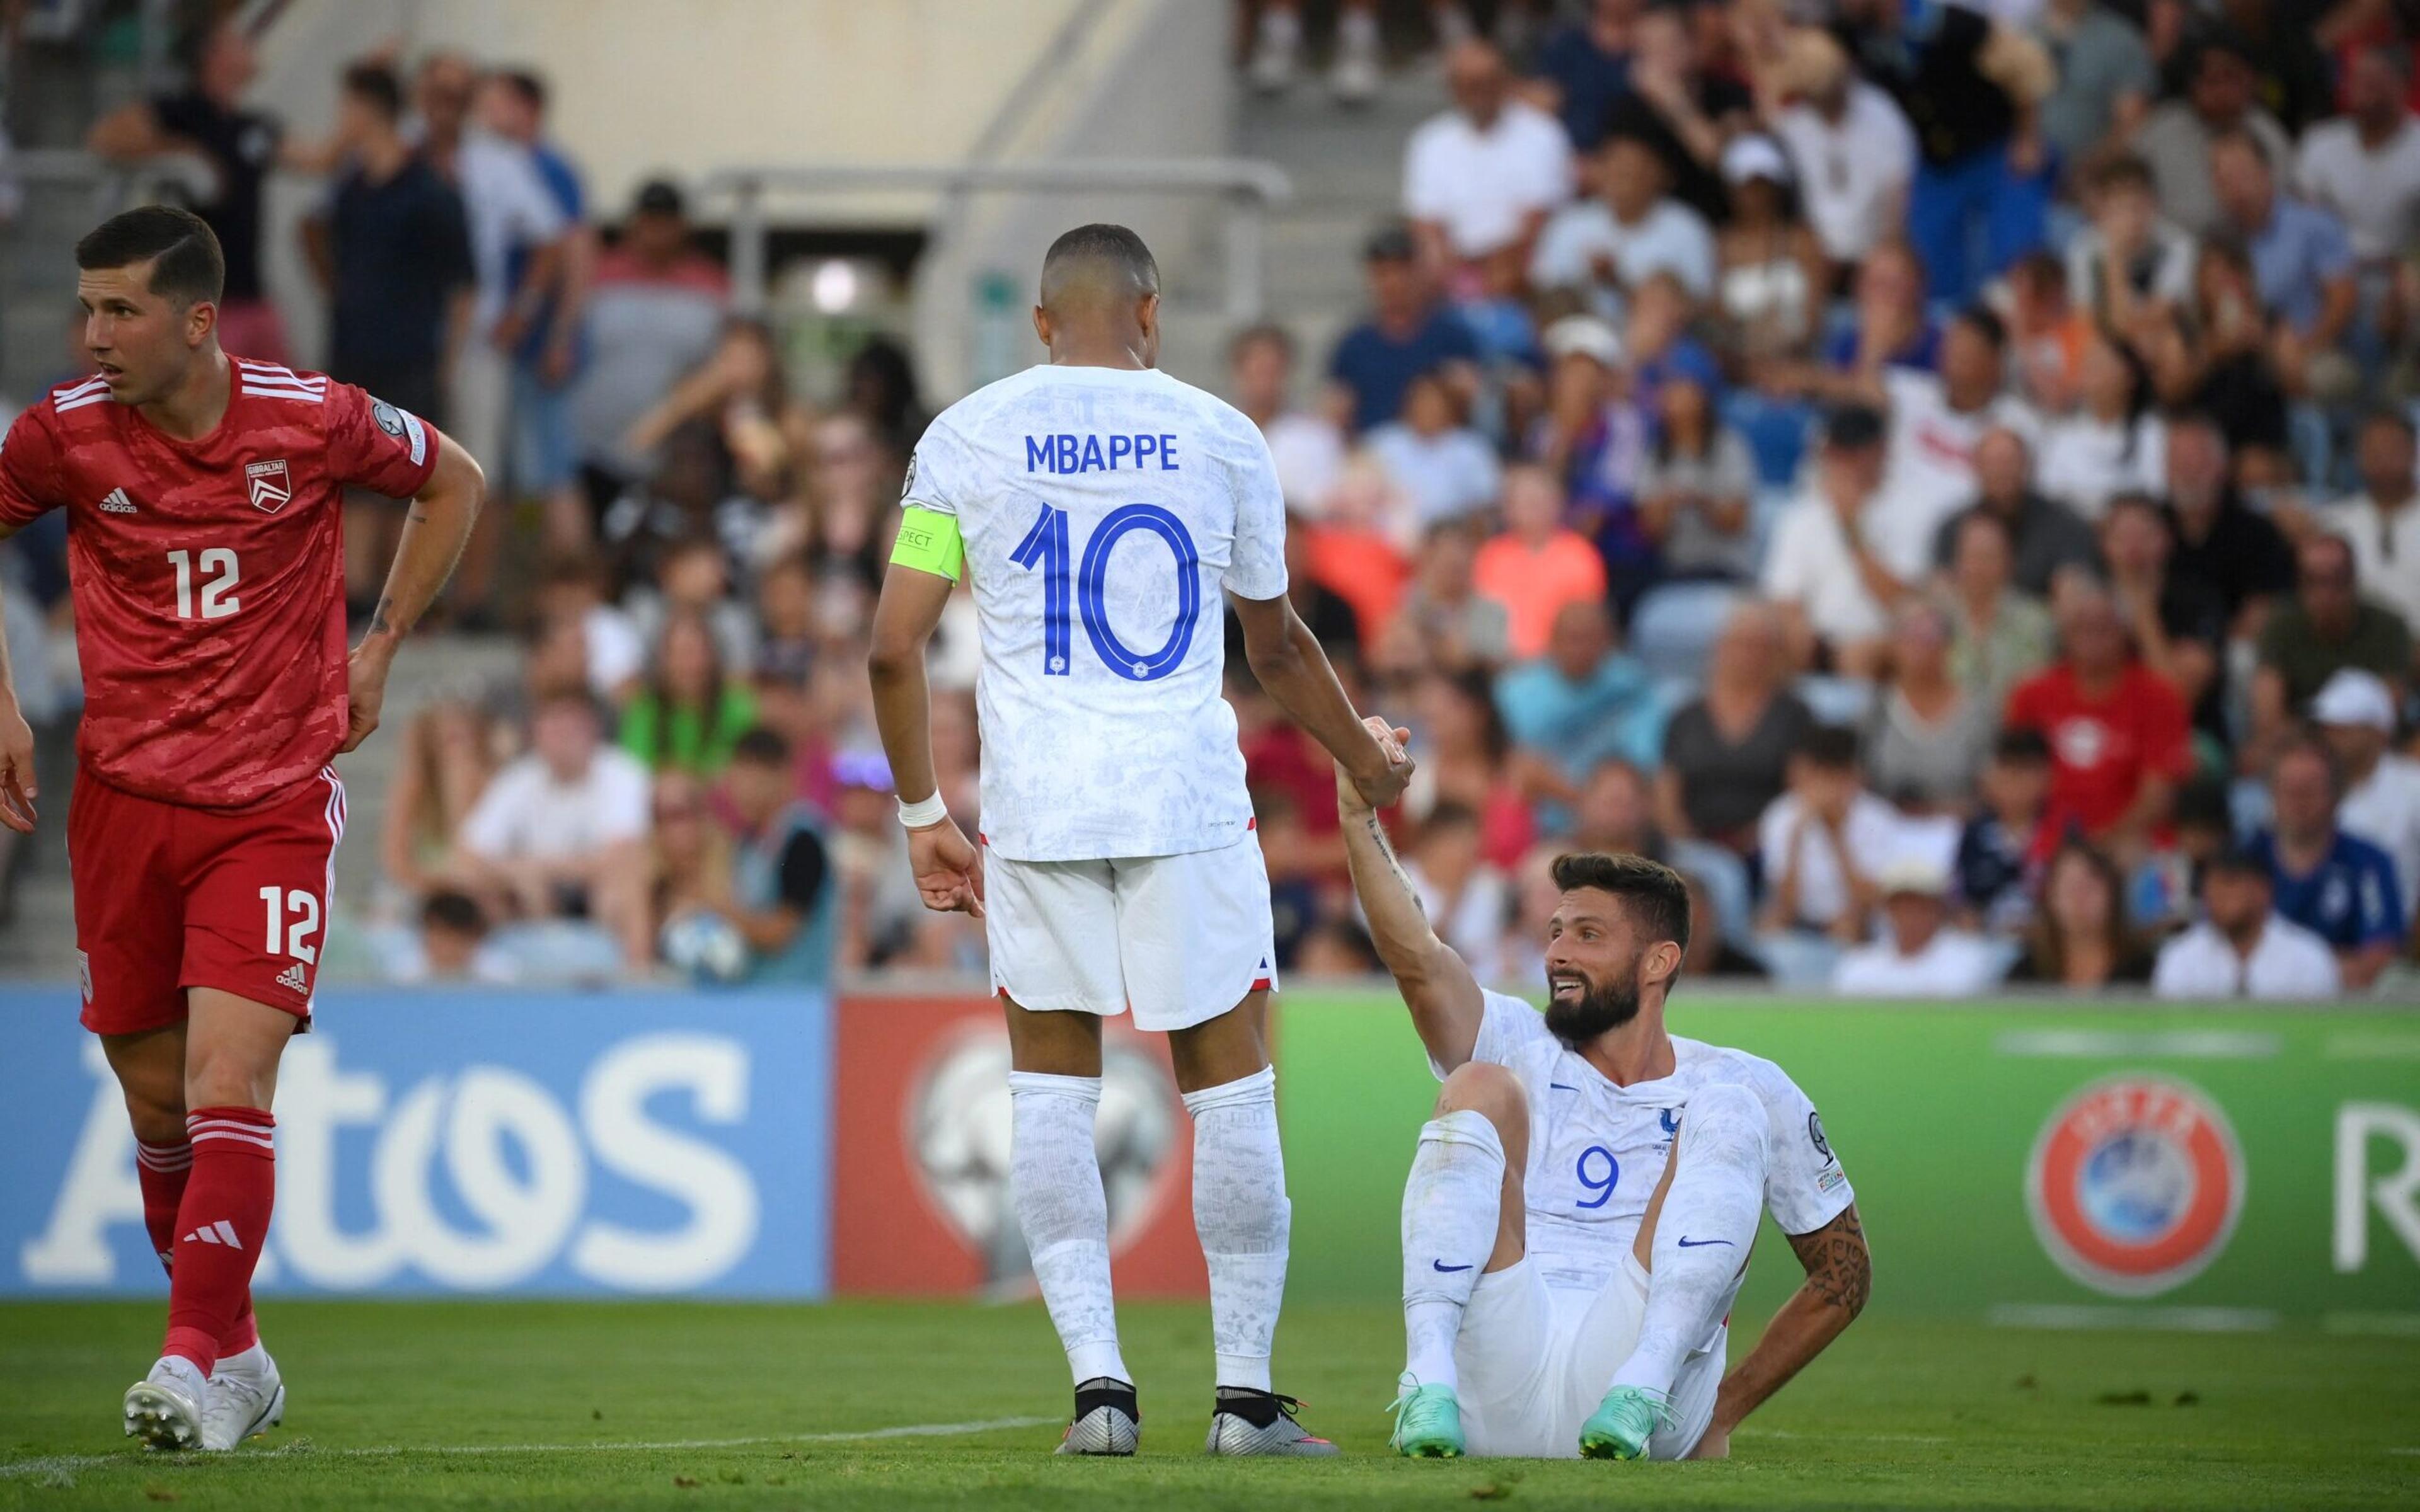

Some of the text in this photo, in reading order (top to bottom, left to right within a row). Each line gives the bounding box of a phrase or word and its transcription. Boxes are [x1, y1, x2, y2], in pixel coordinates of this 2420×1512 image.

[248, 462, 284, 474] GIBRALTAR
[1025, 434, 1179, 474] MBAPPE
[99, 503, 137, 513] adidas
[898, 530, 932, 546] SPECT
[167, 547, 240, 619] 12
[1008, 502, 1200, 682] 10
[260, 886, 319, 965] 12
[275, 975, 309, 995] adidas
[1576, 1146, 1619, 1208] 9
[2334, 1102, 2420, 1274] R
